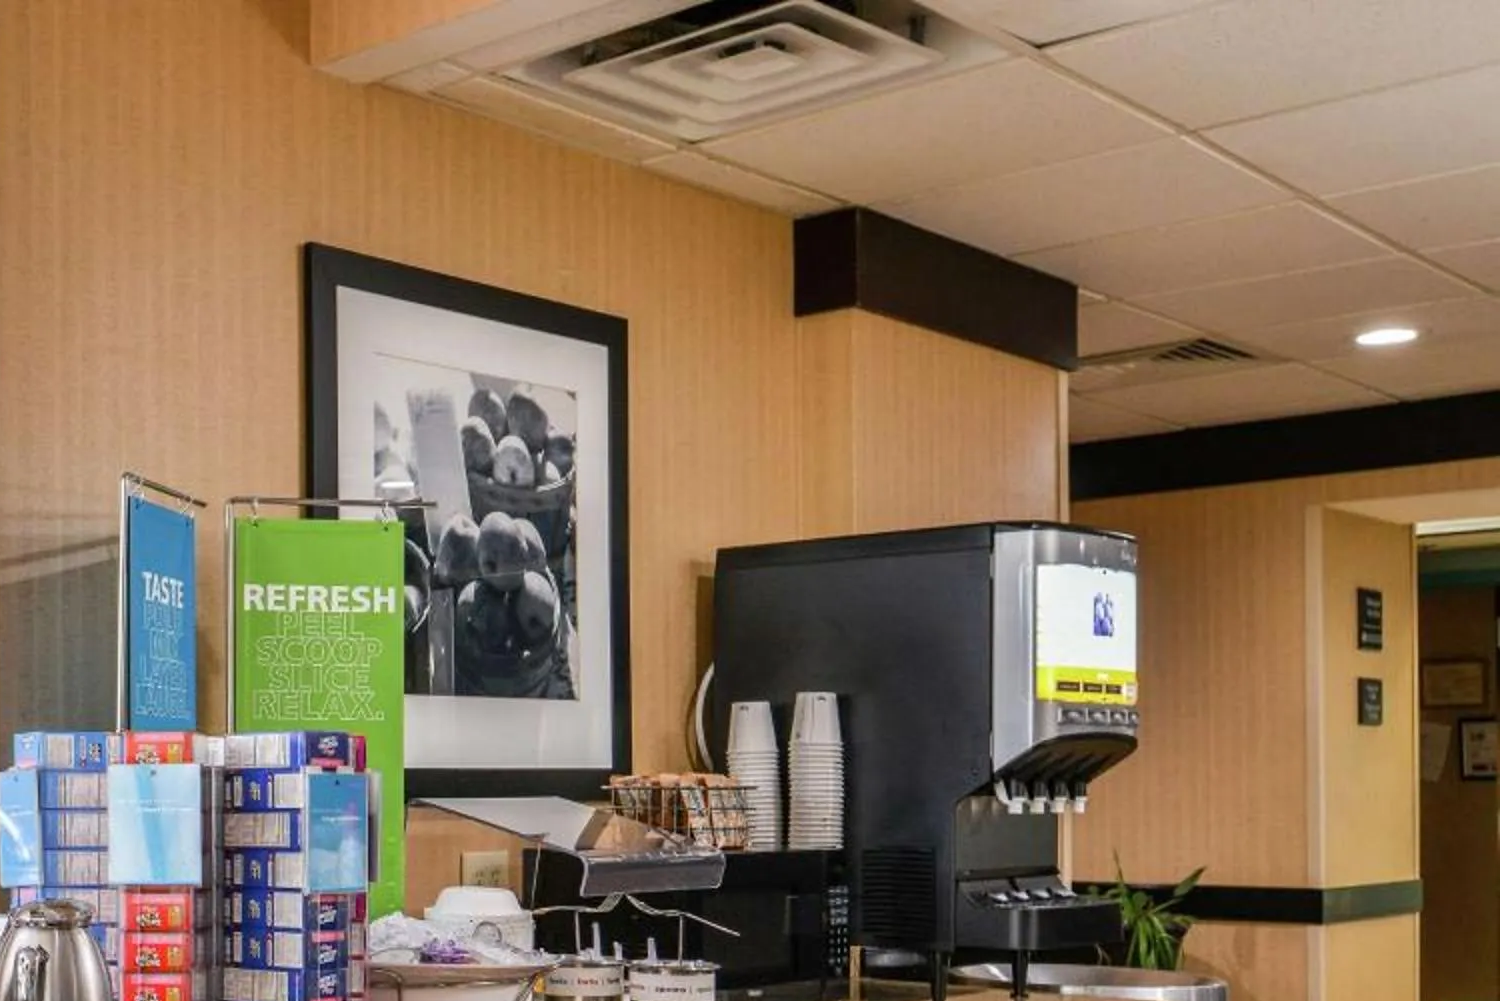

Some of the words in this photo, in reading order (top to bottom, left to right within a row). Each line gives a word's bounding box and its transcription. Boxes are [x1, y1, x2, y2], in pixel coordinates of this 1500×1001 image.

[142, 571, 185, 609] TASTE
[243, 583, 396, 613] REFRESH
[276, 610, 364, 637] PEEL
[257, 636, 383, 667] SCOOP
[269, 665, 371, 692] SLICE
[252, 689, 385, 720] RELAX.
